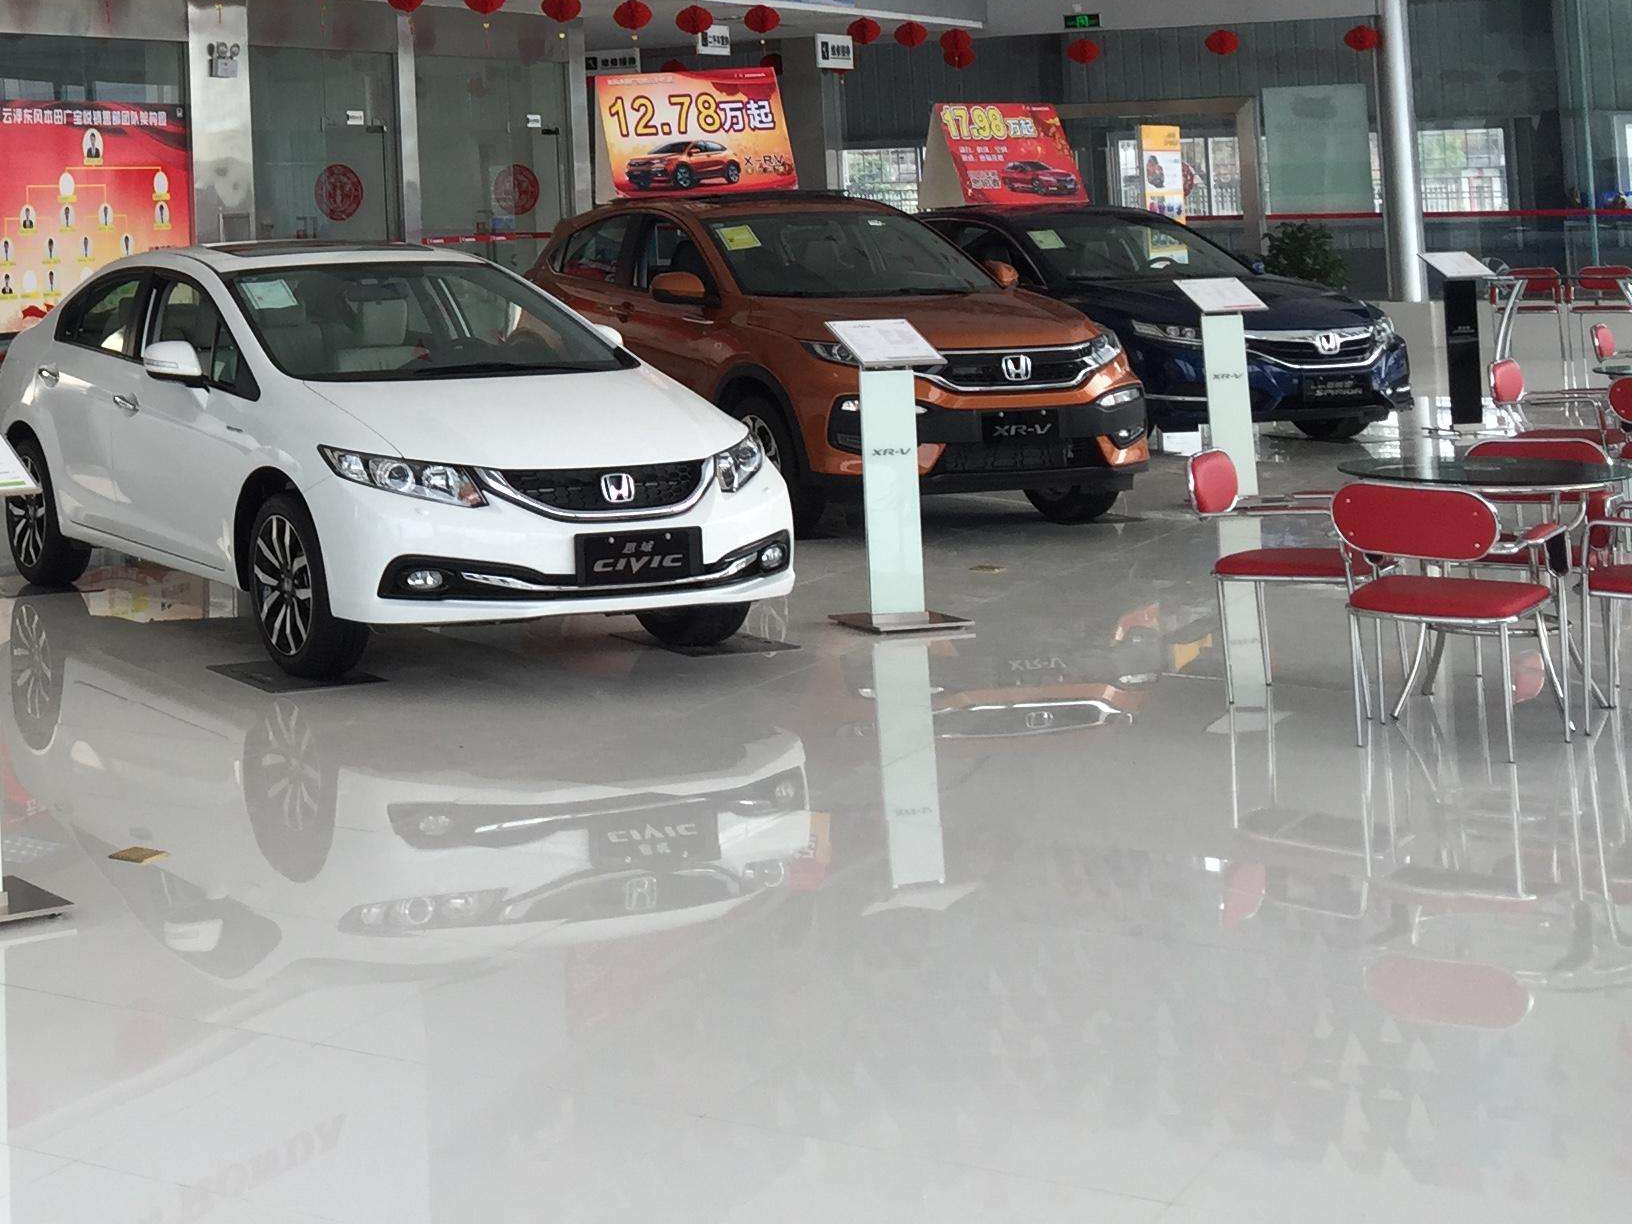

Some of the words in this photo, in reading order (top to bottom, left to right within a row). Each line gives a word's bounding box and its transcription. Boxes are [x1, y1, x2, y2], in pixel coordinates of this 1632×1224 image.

[609, 92, 776, 137] 12.78万起
[992, 423, 1052, 436] XR-V
[872, 447, 911, 456] XR-V
[593, 554, 683, 574] CIVIC
